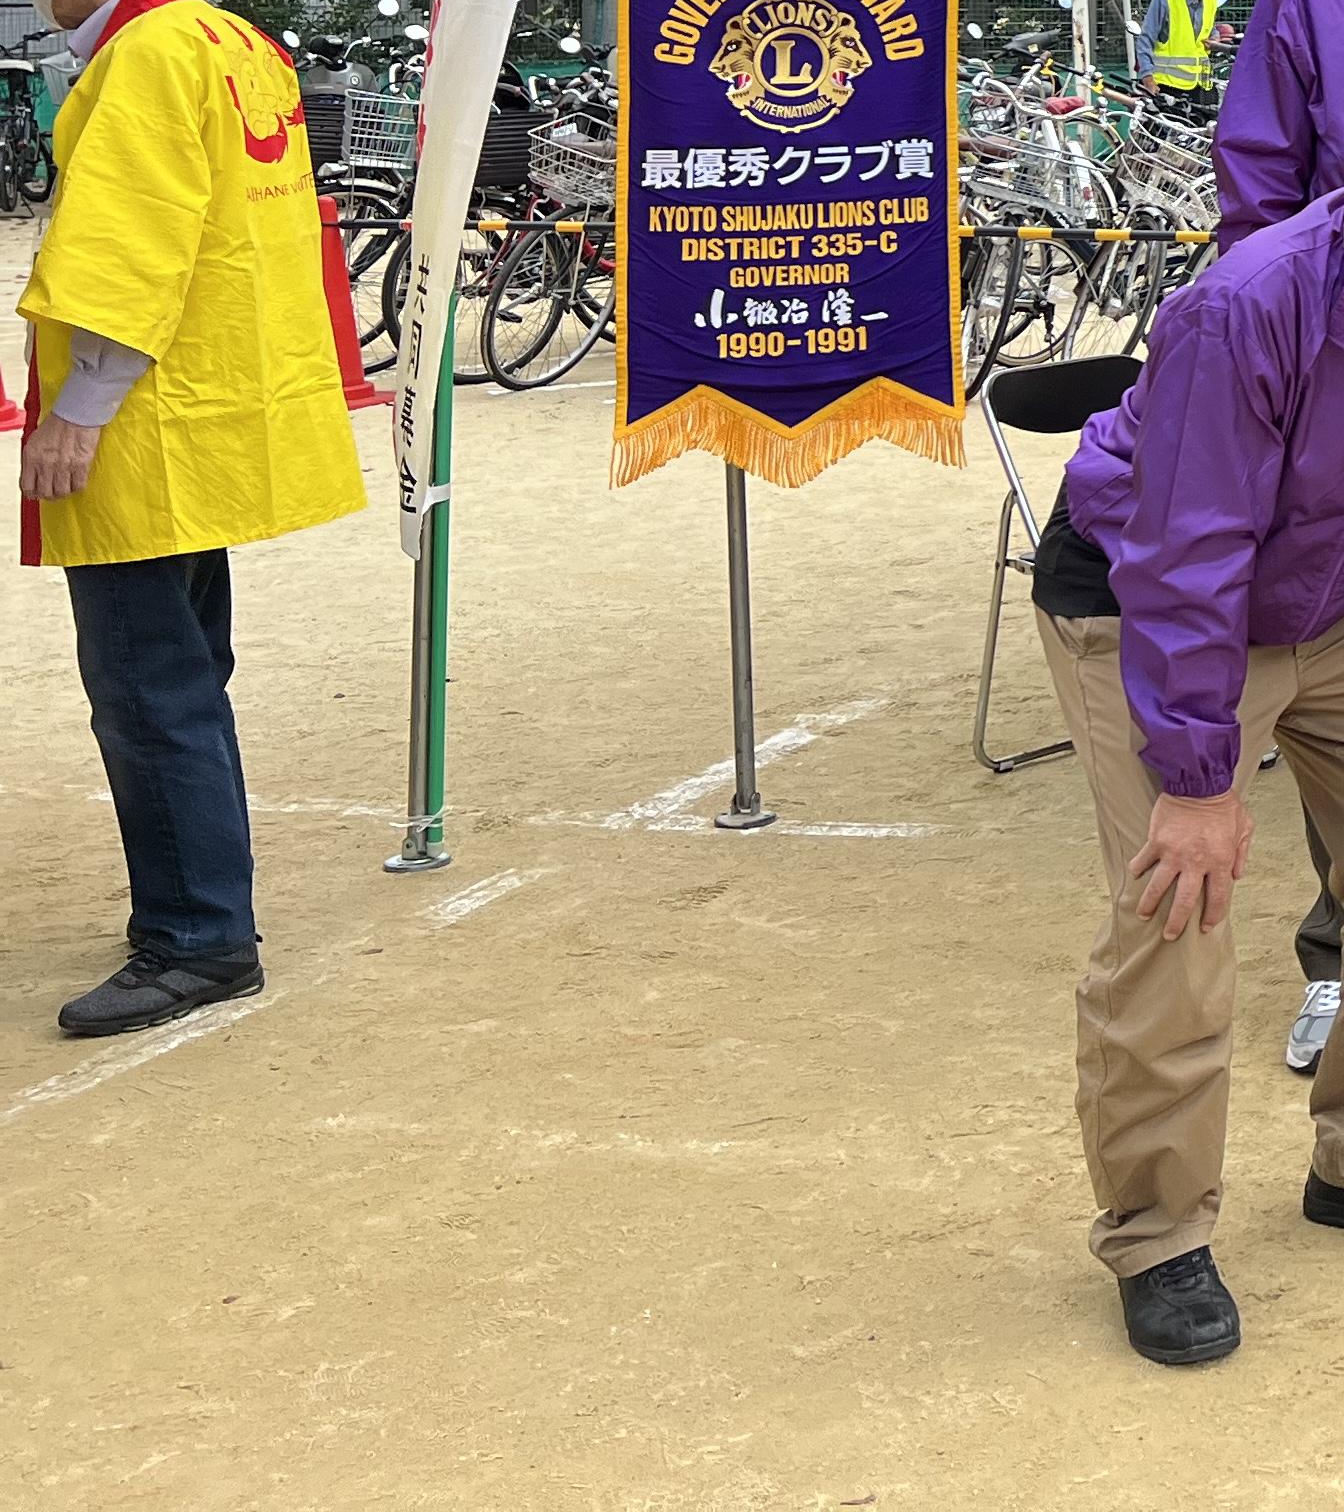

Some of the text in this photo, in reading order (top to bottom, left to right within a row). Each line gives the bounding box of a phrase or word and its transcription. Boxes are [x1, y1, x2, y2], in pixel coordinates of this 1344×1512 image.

[752, 1, 832, 33] LIONS
[769, 39, 814, 85] L
[752, 95, 830, 119] INTERNATIONAL
[641, 138, 935, 190] 最優秀クラブ賞
[649, 196, 930, 233] KYOTO SHUJAKU LIONS CLUB
[681, 230, 898, 262] DISTRICT 335-C
[729, 262, 850, 289] GOVERNOR
[715, 325, 868, 359] 1990-1991
